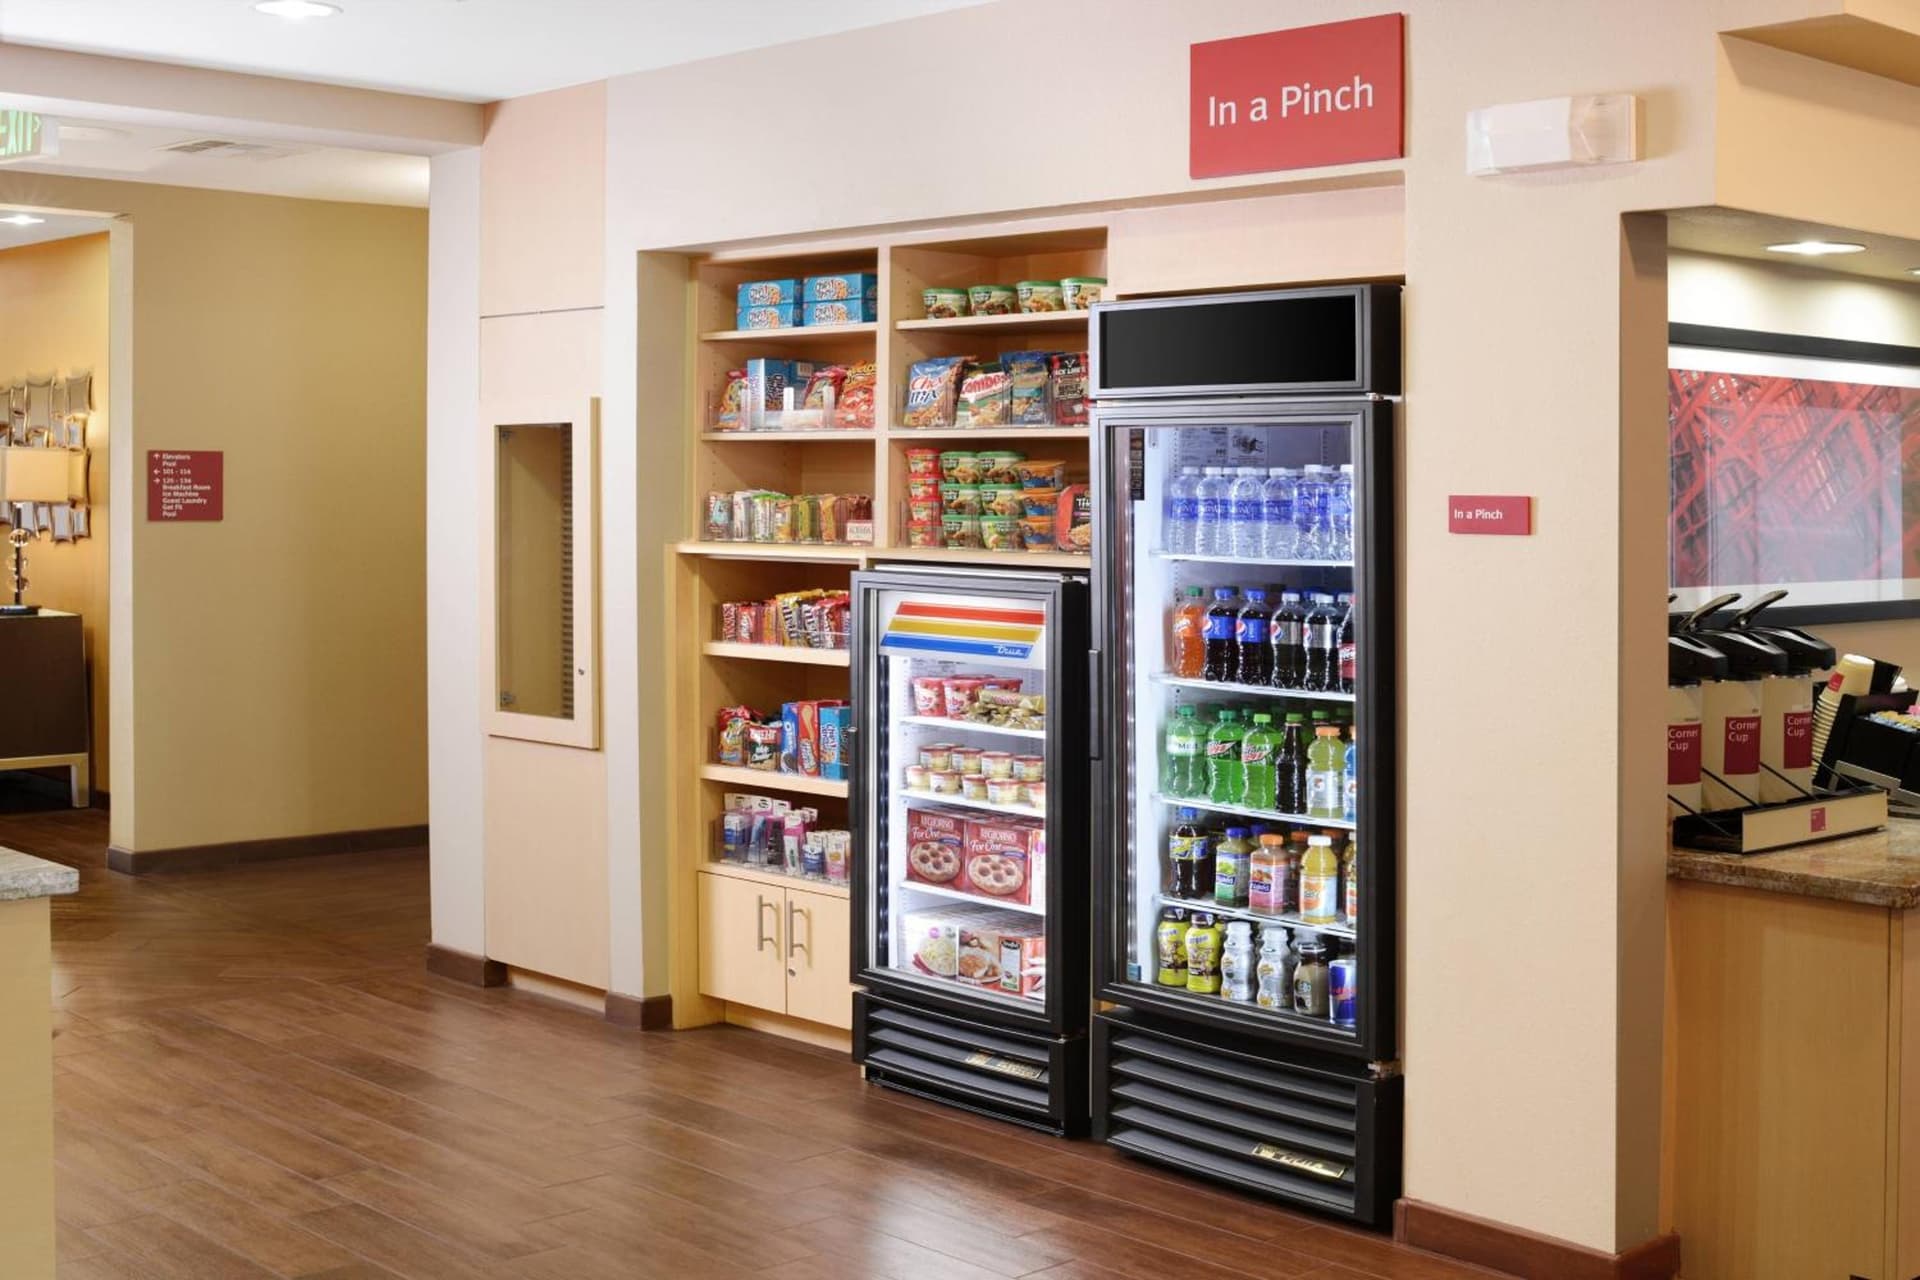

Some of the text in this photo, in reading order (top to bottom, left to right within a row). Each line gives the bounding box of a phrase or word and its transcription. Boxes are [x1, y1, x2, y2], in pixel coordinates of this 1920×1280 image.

[1209, 75, 1373, 127] In a Pinch
[1454, 508, 1503, 520] In a Pinch
[1728, 732, 1749, 744] Cup
[1787, 727, 1805, 738] Cup
[1669, 740, 1689, 752] Cup
